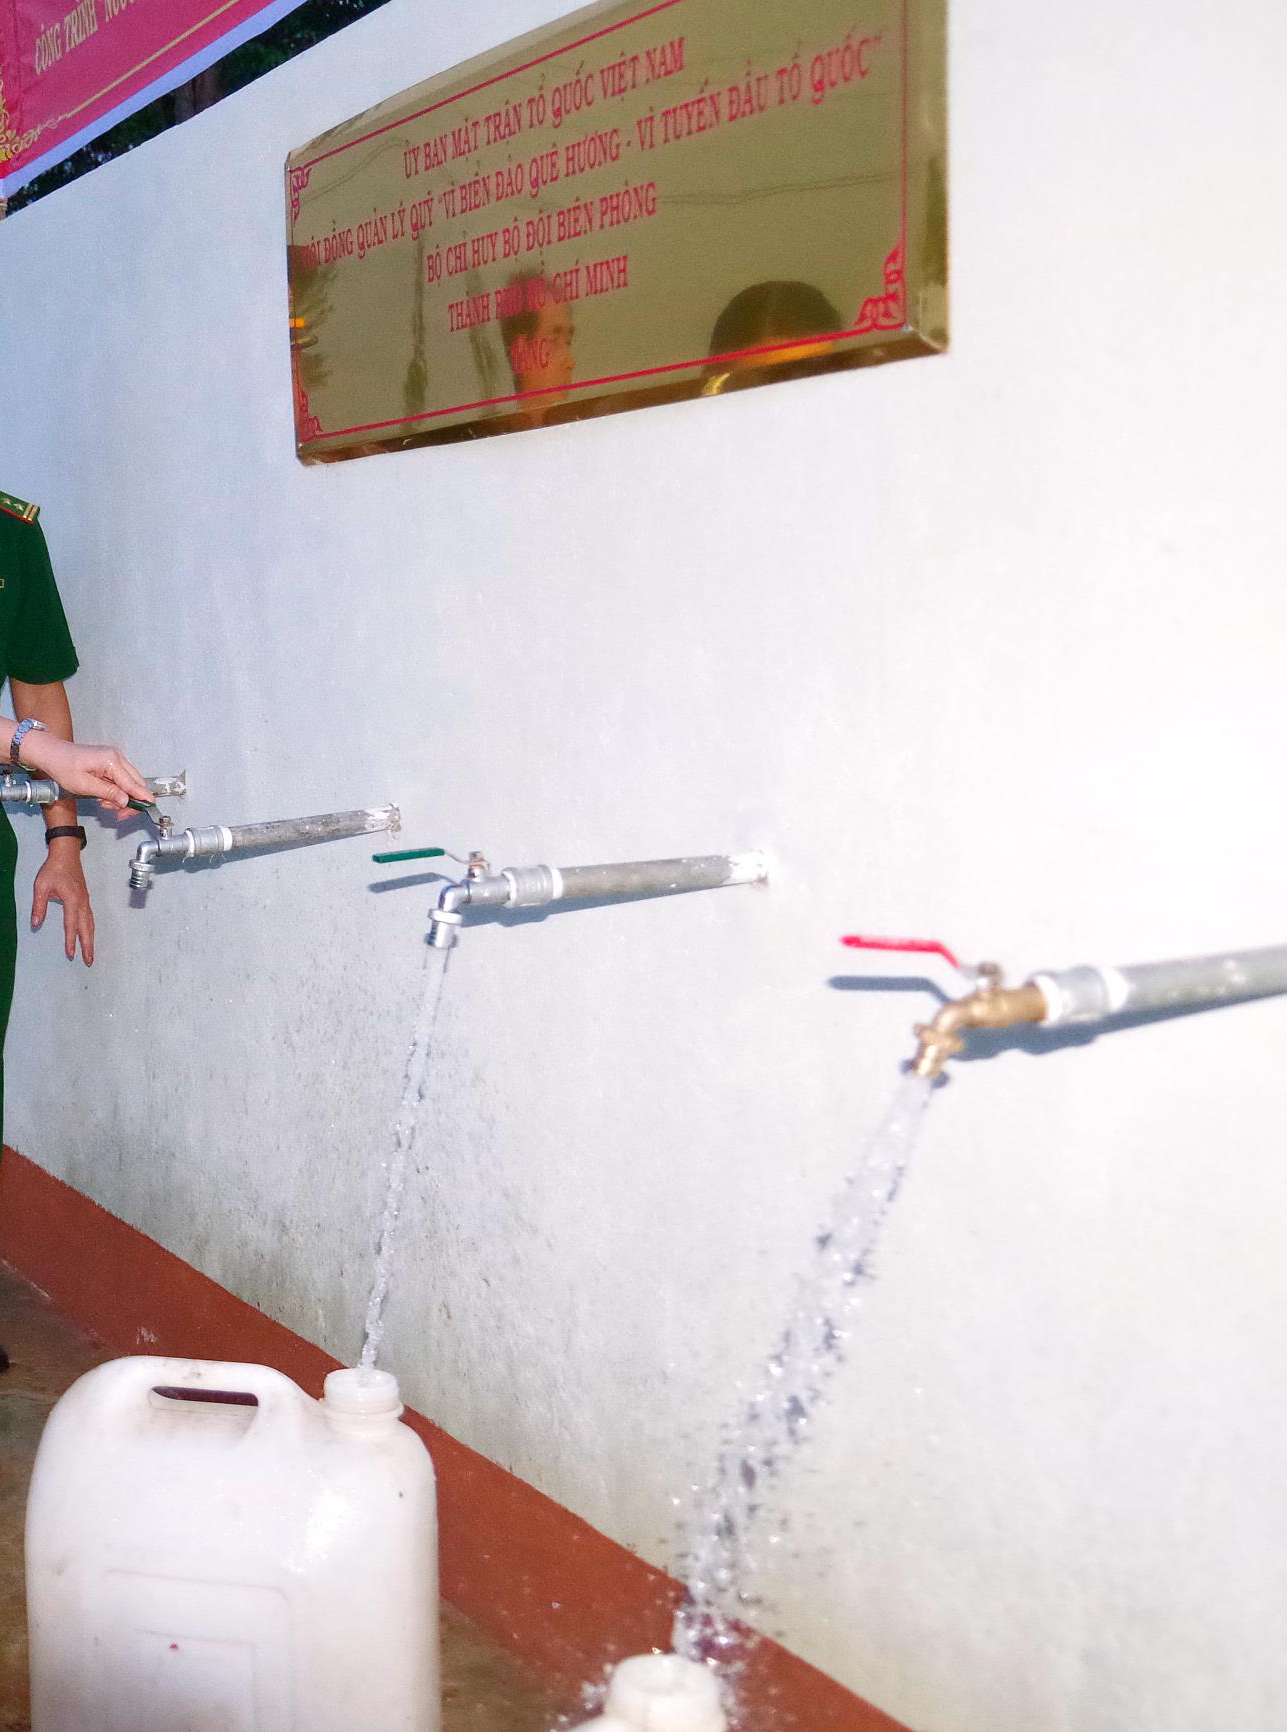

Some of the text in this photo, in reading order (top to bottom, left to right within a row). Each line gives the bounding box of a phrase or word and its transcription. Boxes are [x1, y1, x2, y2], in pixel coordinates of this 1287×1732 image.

[422, 134, 448, 172] BAN
[450, 118, 481, 163] MẶT
[483, 99, 522, 148] TRẬN
[526, 72, 547, 130] TỔ
[550, 60, 594, 129] QUỐC
[599, 51, 641, 103] VIỆT
[644, 35, 685, 85] NAM
[323, 220, 354, 265] ĐỒNG
[356, 207, 389, 260] QUẢN
[391, 201, 407, 241] LÝ
[495, 154, 525, 202] ĐẢO
[528, 141, 560, 200] QUÊ
[636, 105, 656, 151] VÌ
[661, 78, 722, 145] TUYẾN
[425, 243, 443, 287] BỘ
[471, 231, 499, 269] HUY
[502, 215, 521, 263] BỘ
[525, 207, 553, 256] ĐỘI
[556, 196, 594, 243] BIÊN
[599, 179, 658, 231] PHÒNG
[552, 258, 582, 306] CHÍ
[584, 255, 629, 298] MINH
